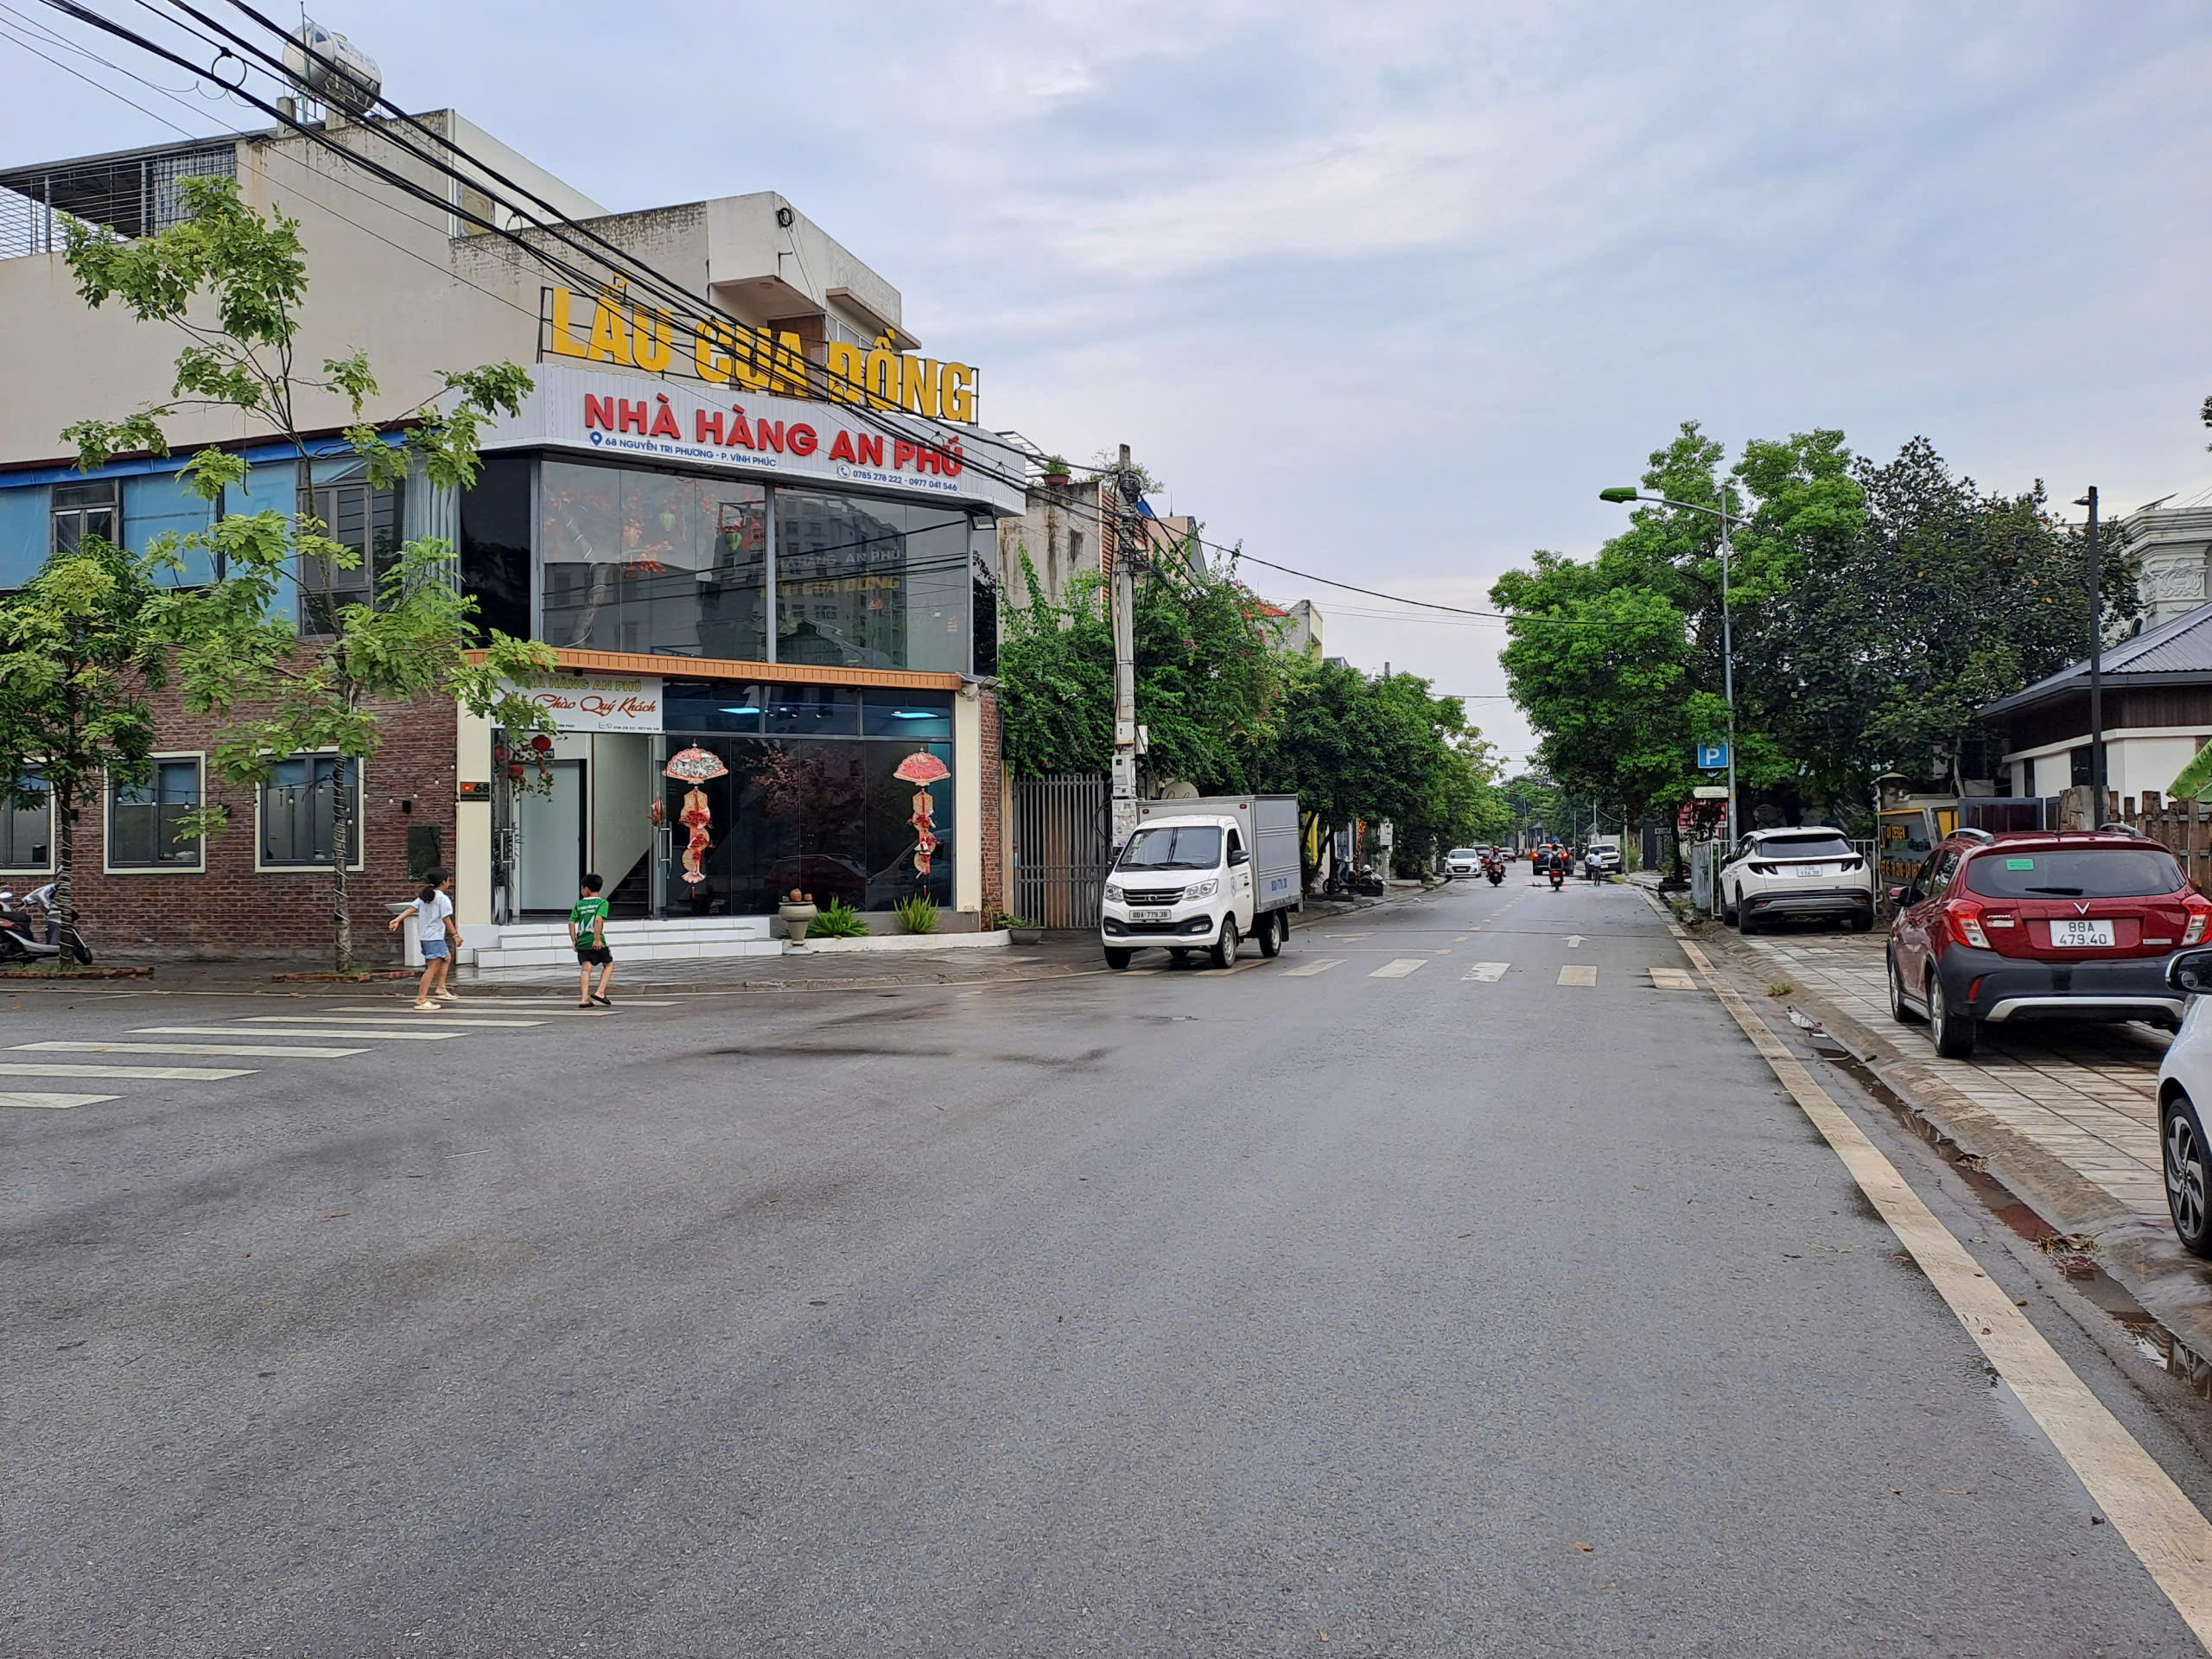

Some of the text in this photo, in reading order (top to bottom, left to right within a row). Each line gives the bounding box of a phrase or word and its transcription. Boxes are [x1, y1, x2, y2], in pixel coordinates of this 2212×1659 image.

[695, 317, 808, 397] CUA
[827, 327, 973, 423] ĐỒNG
[585, 392, 963, 476] NHÀ HÀNG AN PHÚ
[605, 437, 617, 447] 68
[619, 439, 658, 451] NGUYỄN
[675, 446, 714, 459] PHƯƠNG
[721, 453, 728, 461] P.
[730, 452, 750, 464] VĨNH
[753, 454, 776, 467] PHÚC
[852, 469, 872, 480] 0785
[873, 472, 887, 481] 278
[888, 474, 902, 484] 222
[909, 477, 927, 488] 0977
[929, 480, 941, 489] 041
[943, 482, 958, 492] 546
[593, 680, 612, 690] AN
[580, 695, 617, 717] Quý
[617, 696, 657, 718] Khách
[1707, 747, 1720, 765] P
[474, 783, 490, 793] 68
[2069, 921, 2094, 933] 88A
[2059, 933, 2107, 945] 479.40
